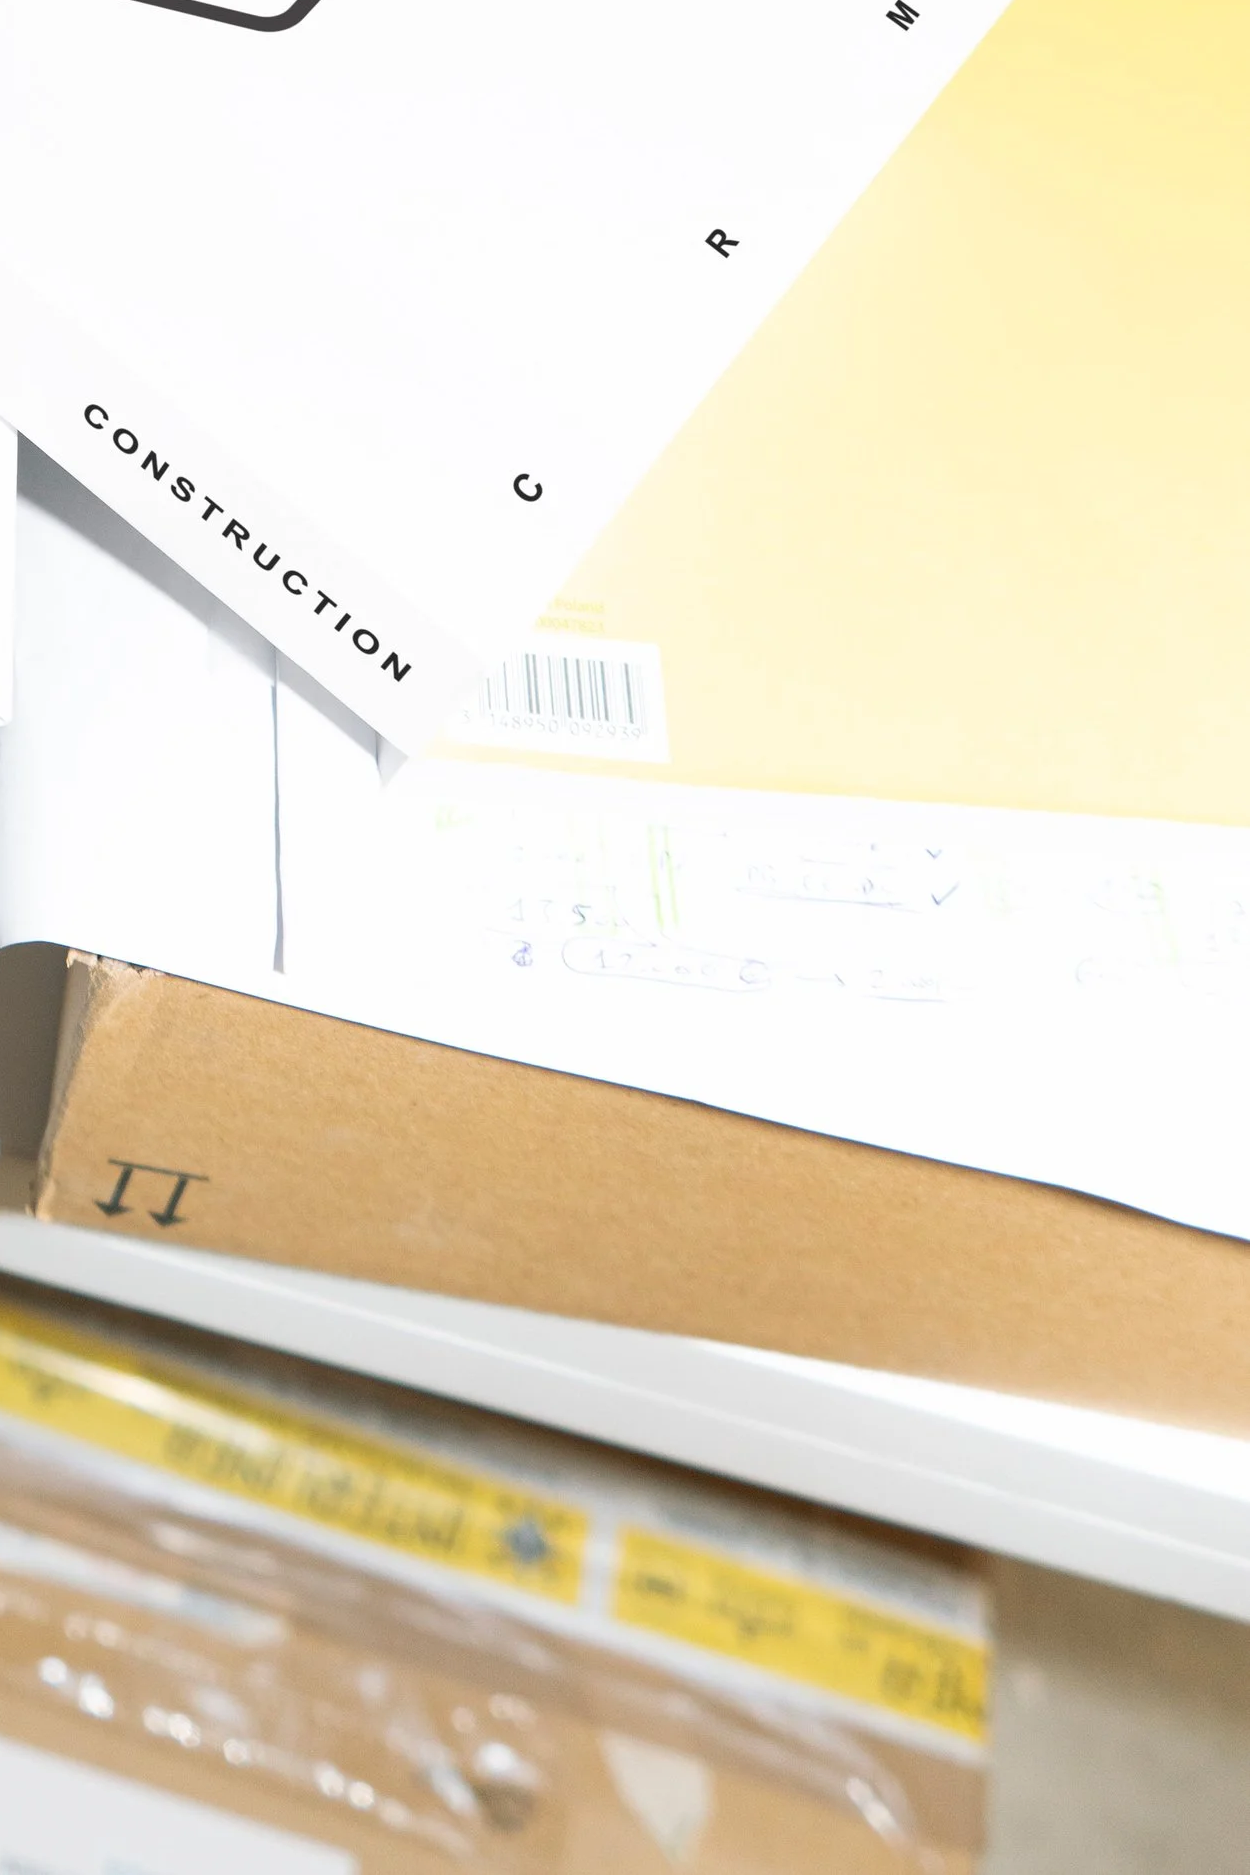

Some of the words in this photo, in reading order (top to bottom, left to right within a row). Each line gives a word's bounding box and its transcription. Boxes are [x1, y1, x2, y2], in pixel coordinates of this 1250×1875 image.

[513, 474, 542, 502] C
[705, 229, 739, 258] R
[886, 0, 920, 31] M
[84, 404, 411, 682] CONSTRUCTION
